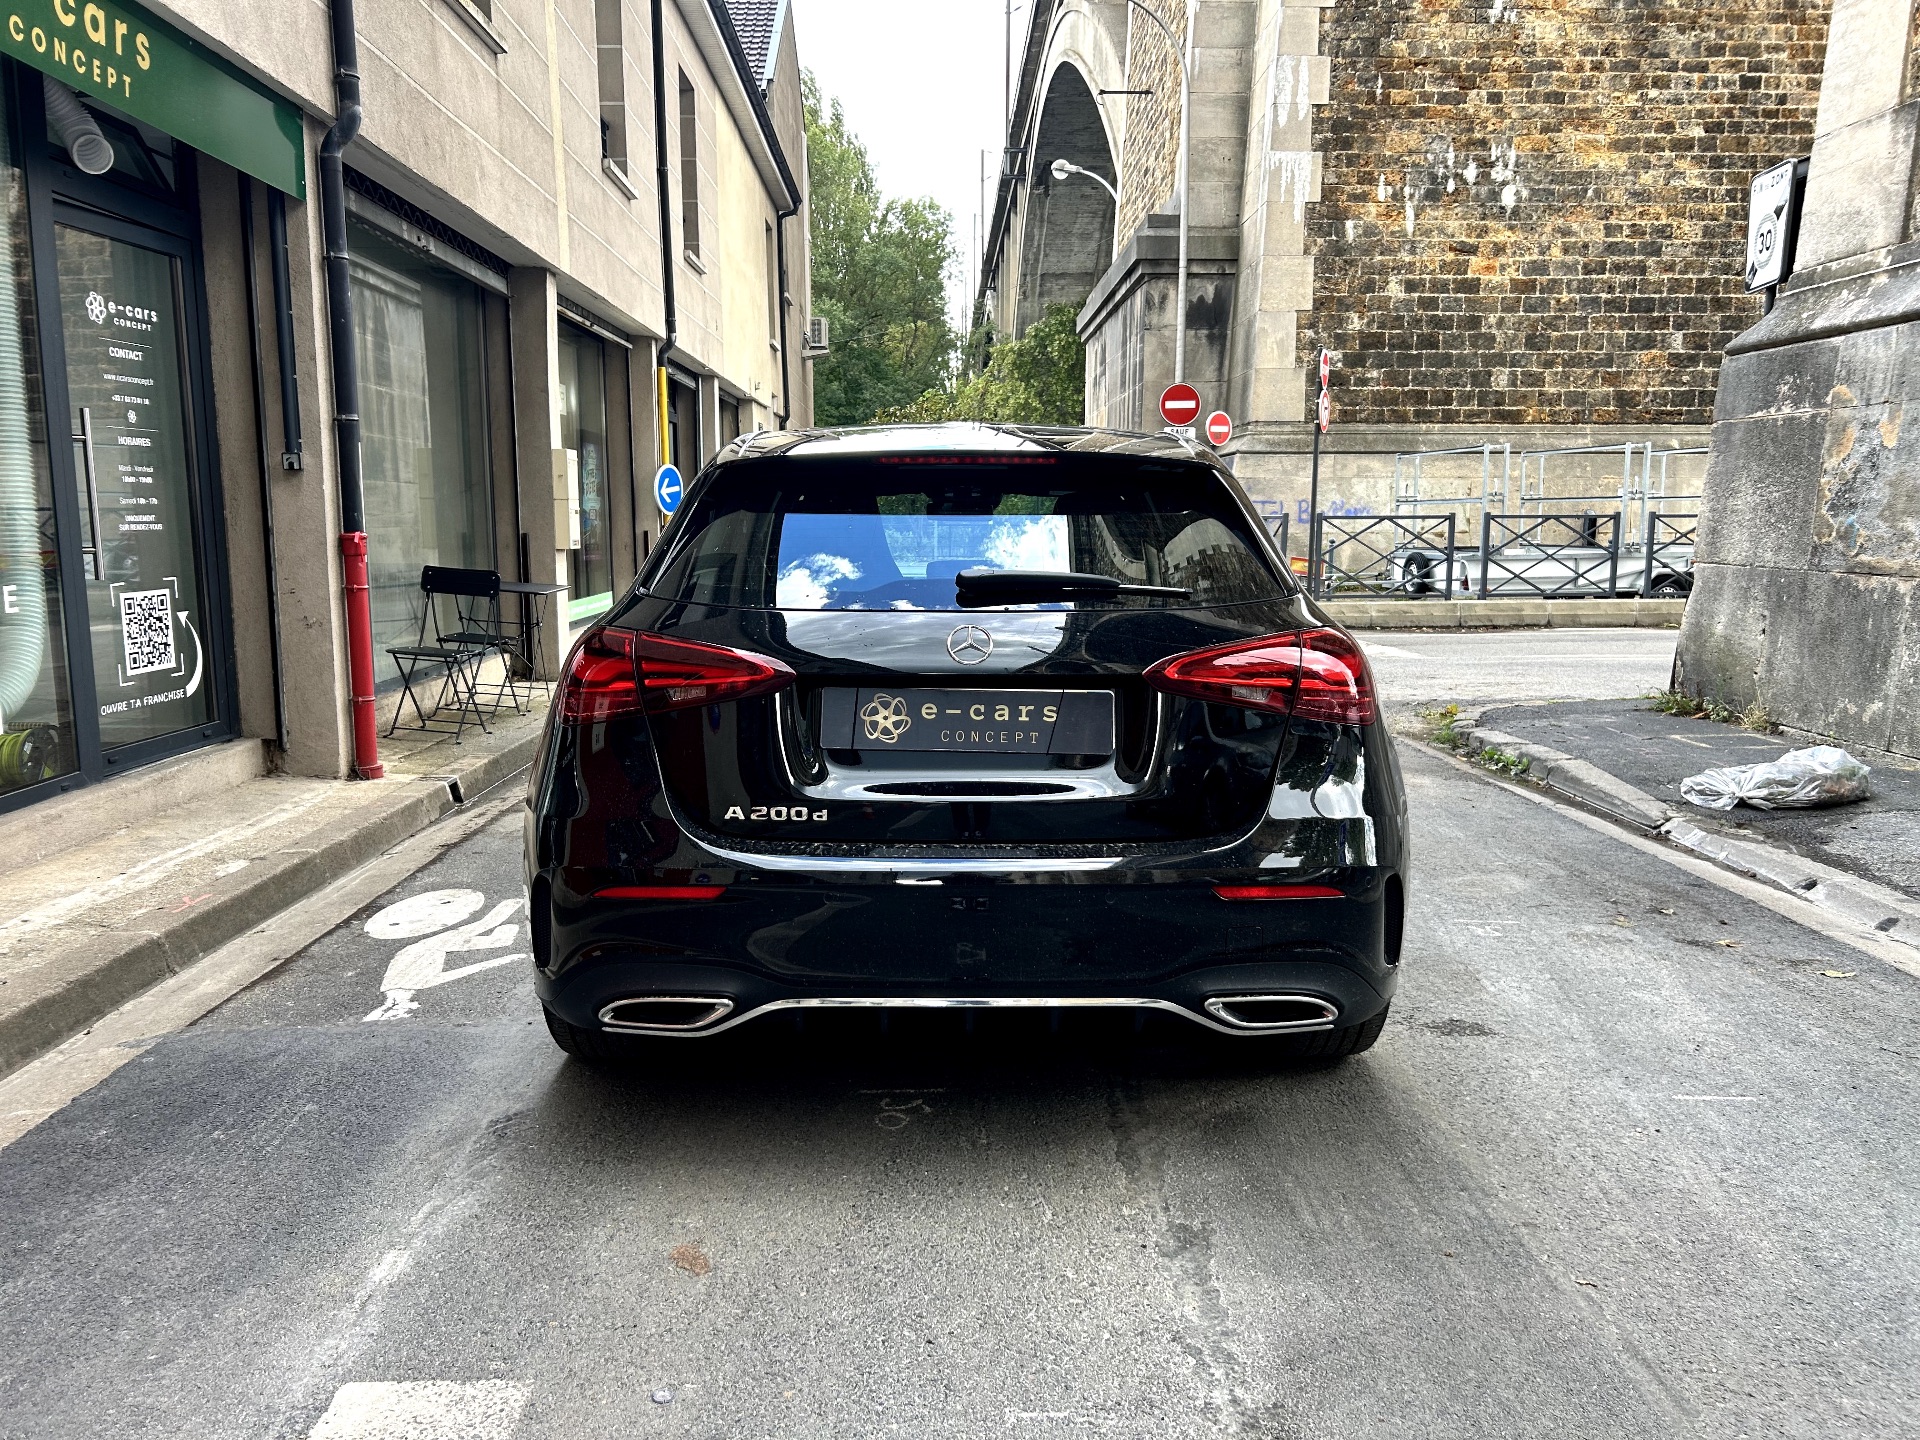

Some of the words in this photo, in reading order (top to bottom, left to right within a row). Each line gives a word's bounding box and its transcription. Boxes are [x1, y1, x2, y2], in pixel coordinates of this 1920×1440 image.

[9, 14, 131, 98] CONCEPT
[1758, 229, 1772, 254] 30
[108, 301, 158, 322] e-cars
[113, 317, 152, 331] CONCEPT
[109, 347, 143, 360] CONTACT
[118, 435, 151, 447] HORAIRES
[101, 701, 128, 716] OUVRE
[130, 698, 141, 709] TA
[143, 688, 185, 706] FRANCHISE
[921, 703, 1058, 722] e-cars
[940, 730, 1039, 744] CONCEPT
